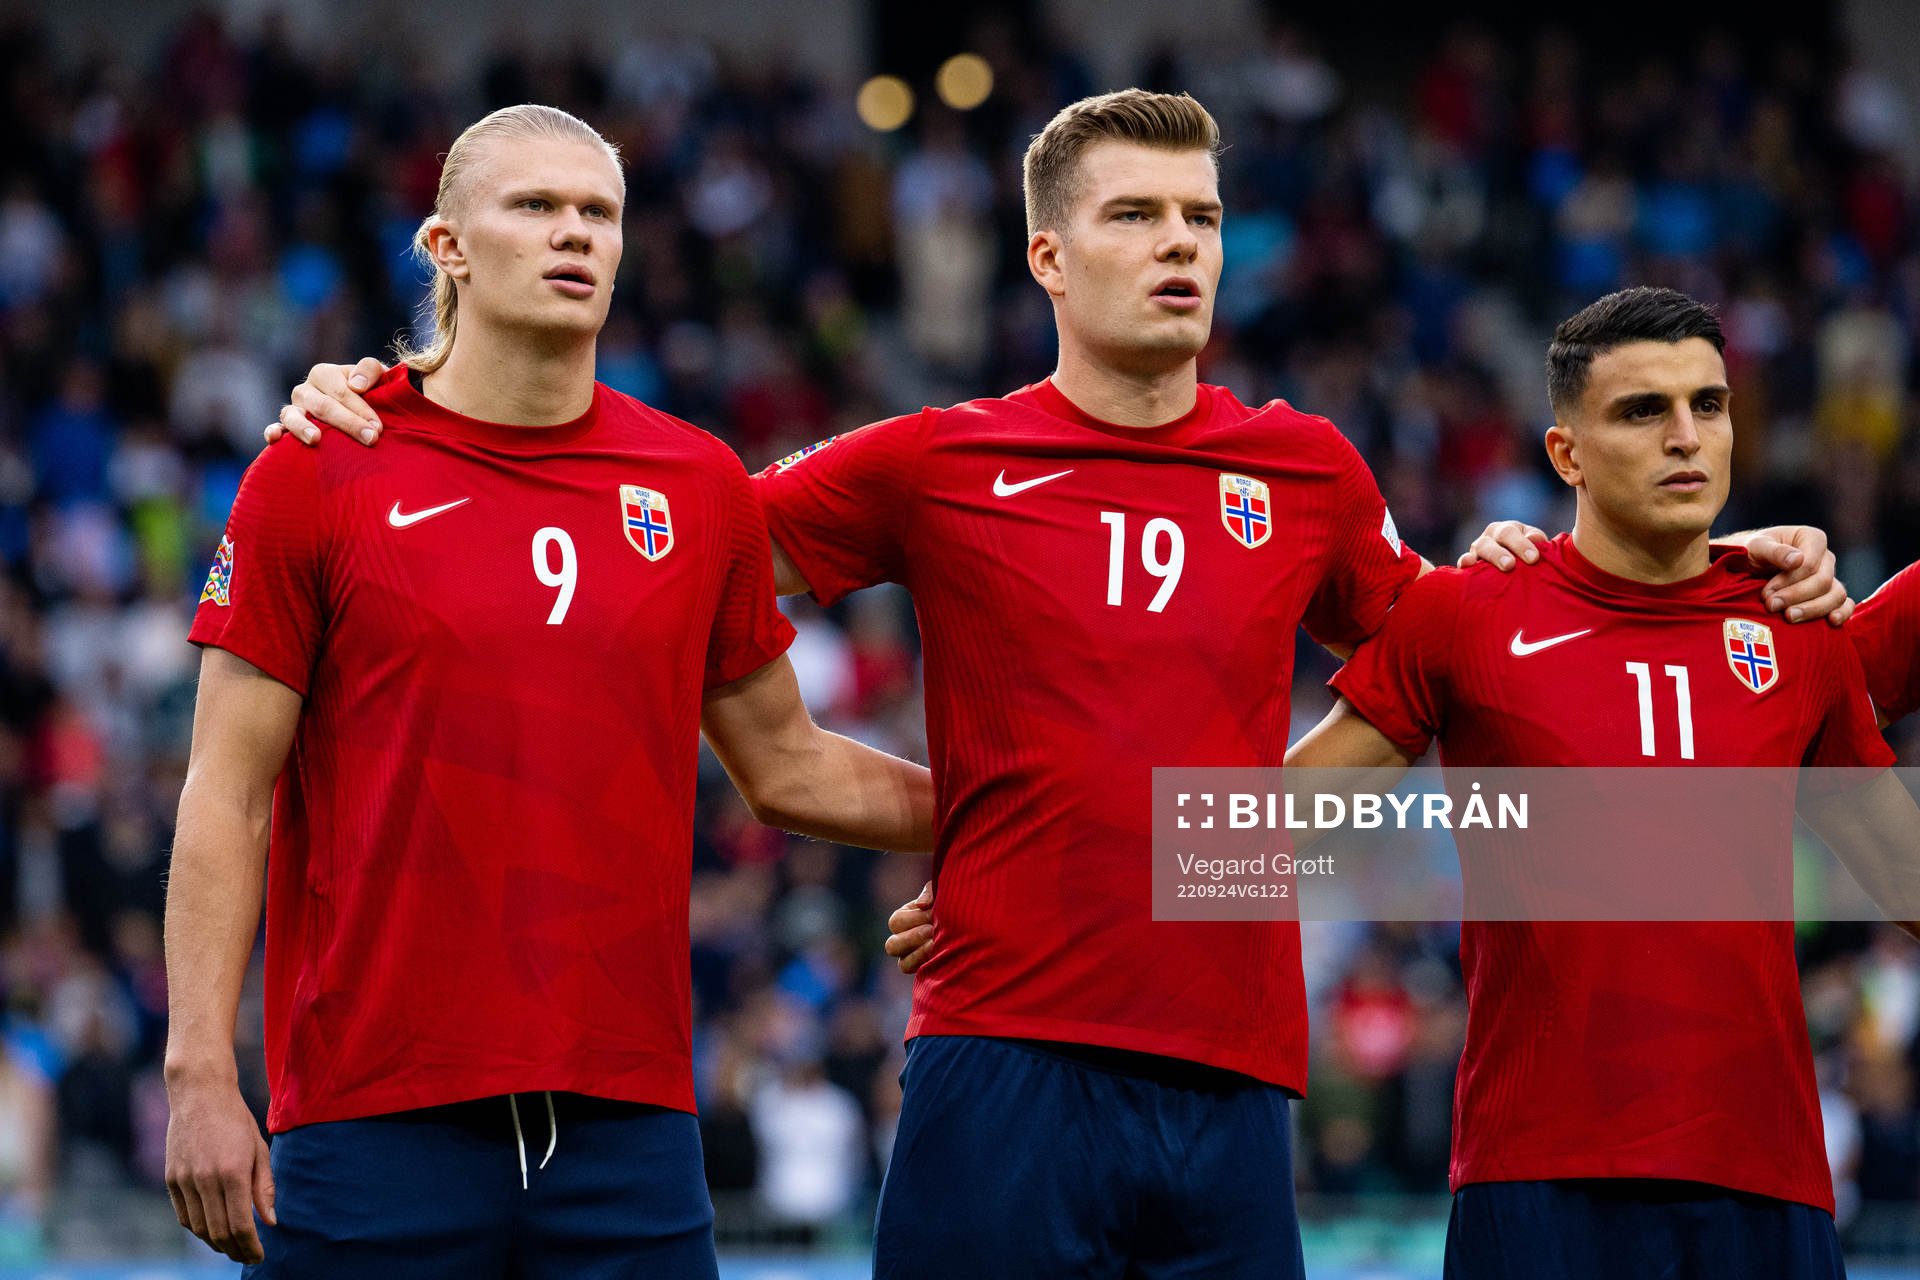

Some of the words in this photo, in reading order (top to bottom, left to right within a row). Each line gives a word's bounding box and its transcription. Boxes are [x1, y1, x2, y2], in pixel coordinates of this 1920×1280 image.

[531, 526, 578, 625] 9
[1099, 511, 1186, 613] 19
[1624, 661, 1695, 760] 11
